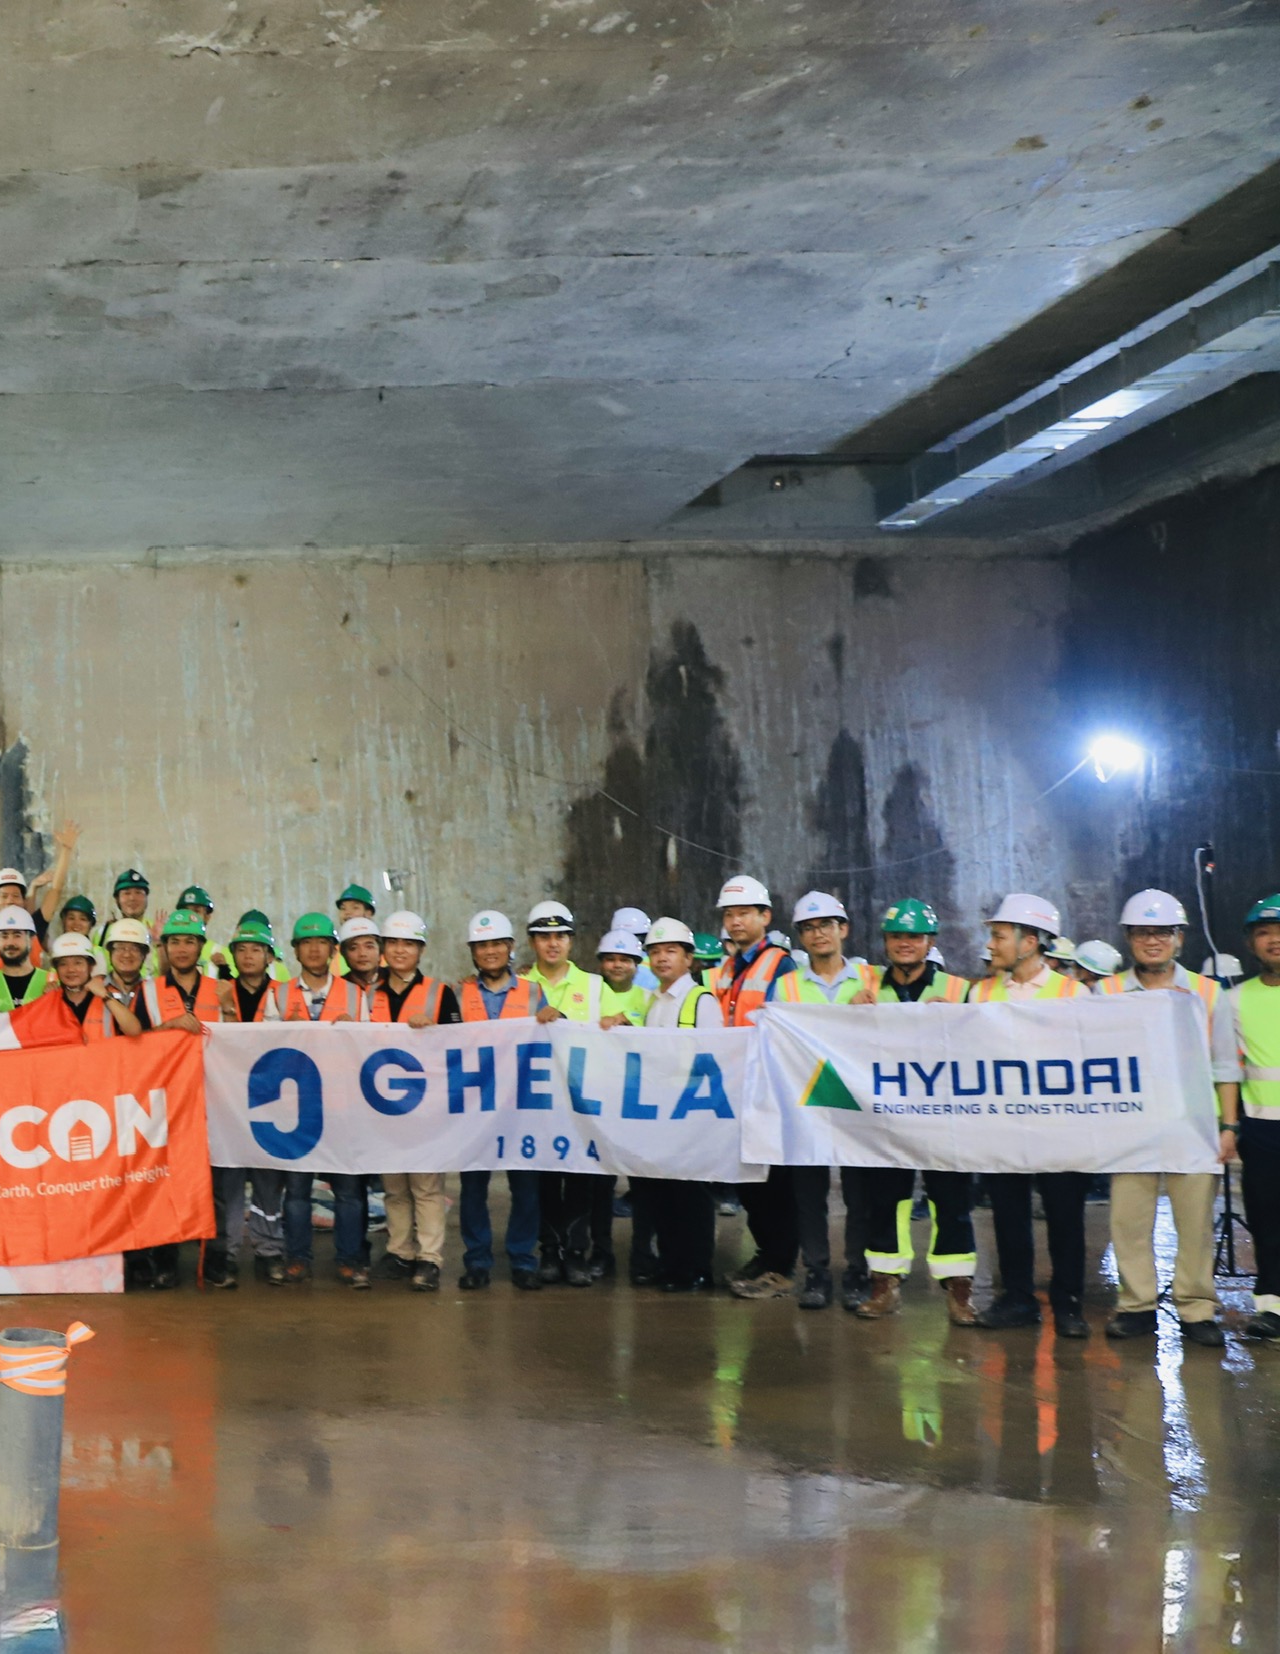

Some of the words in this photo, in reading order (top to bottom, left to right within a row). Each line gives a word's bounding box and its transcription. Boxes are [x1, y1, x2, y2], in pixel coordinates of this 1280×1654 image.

[359, 1043, 735, 1121] GHELLA
[872, 1056, 1141, 1097] HYUNDAI
[873, 1102, 982, 1116] ENGINEERING
[987, 1103, 999, 1115] &
[1004, 1101, 1144, 1115] CONSTRUCTION
[496, 1135, 601, 1162] 1894
[36, 1175, 97, 1196] Conquer
[99, 1174, 122, 1189] the
